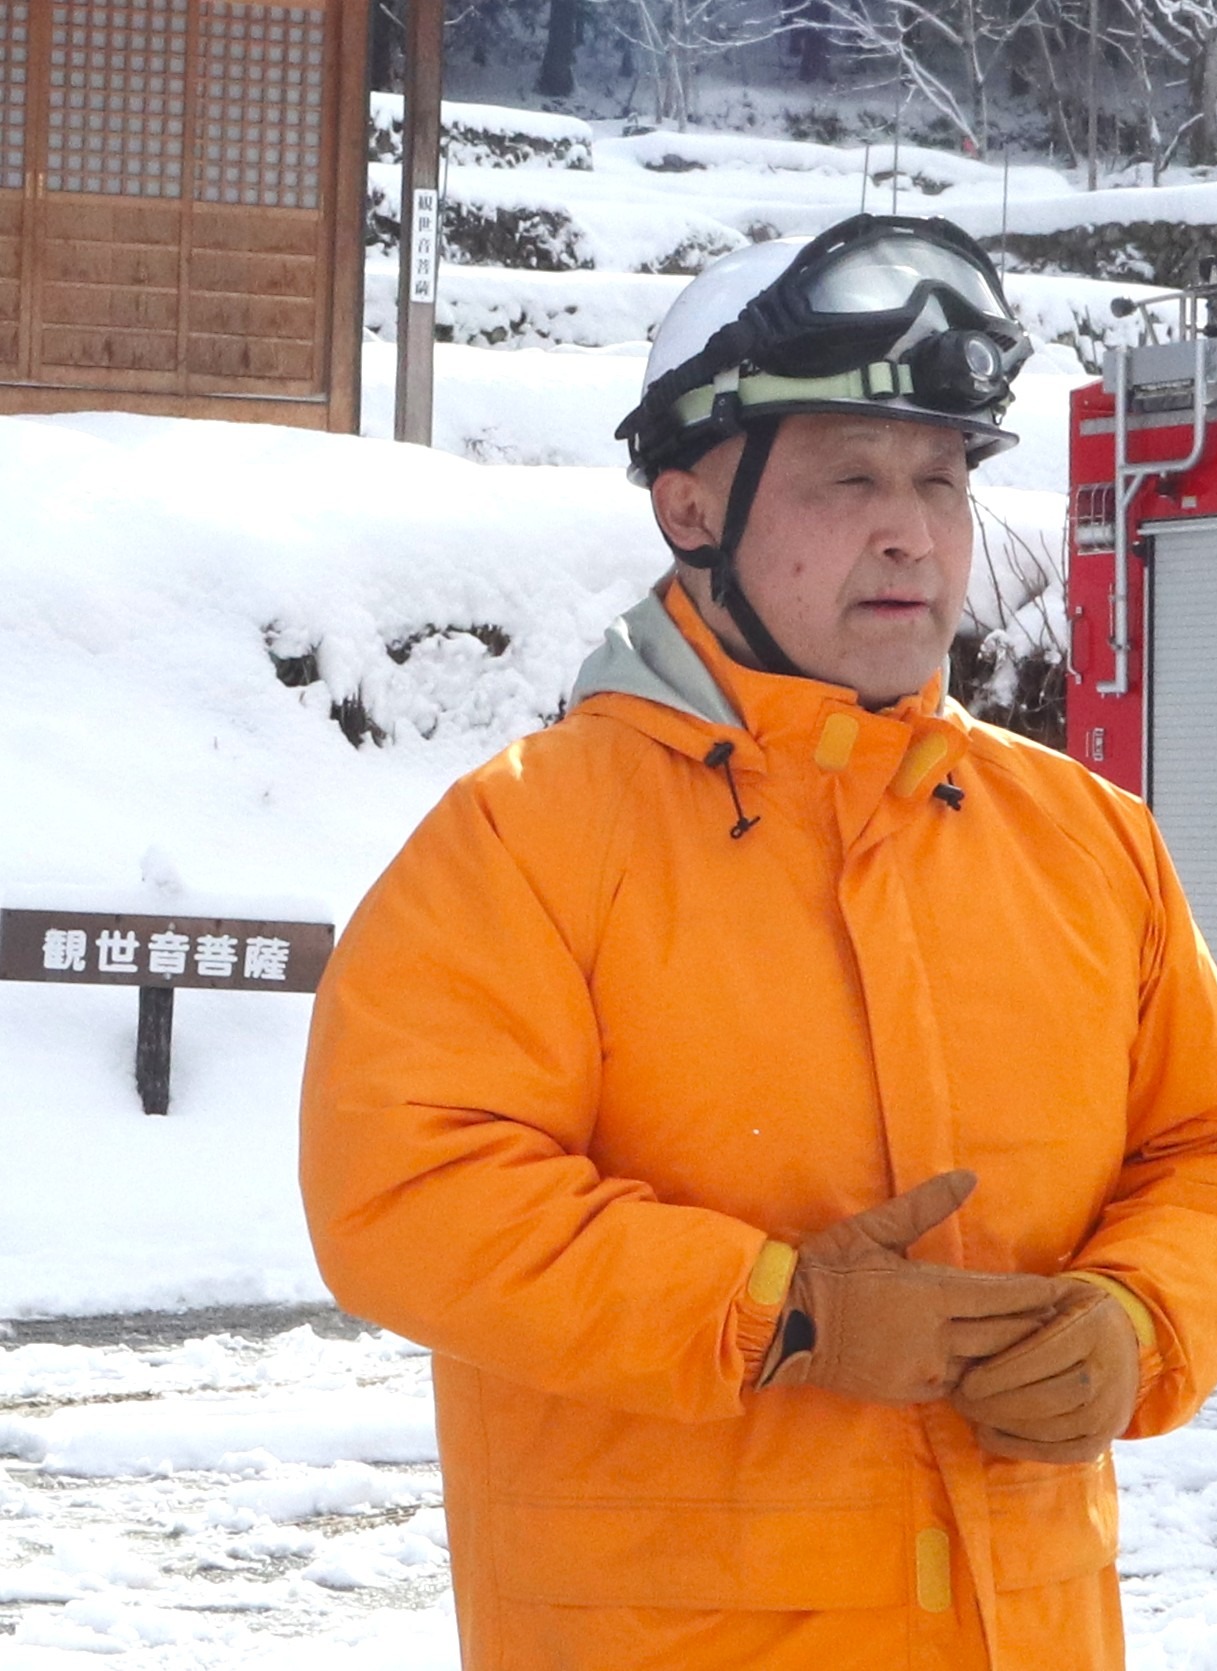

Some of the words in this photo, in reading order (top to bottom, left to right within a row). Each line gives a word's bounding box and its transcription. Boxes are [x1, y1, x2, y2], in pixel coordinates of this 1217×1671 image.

[415, 196, 432, 295] 観世音菩薩
[42, 928, 290, 981] 観世音菩薩
